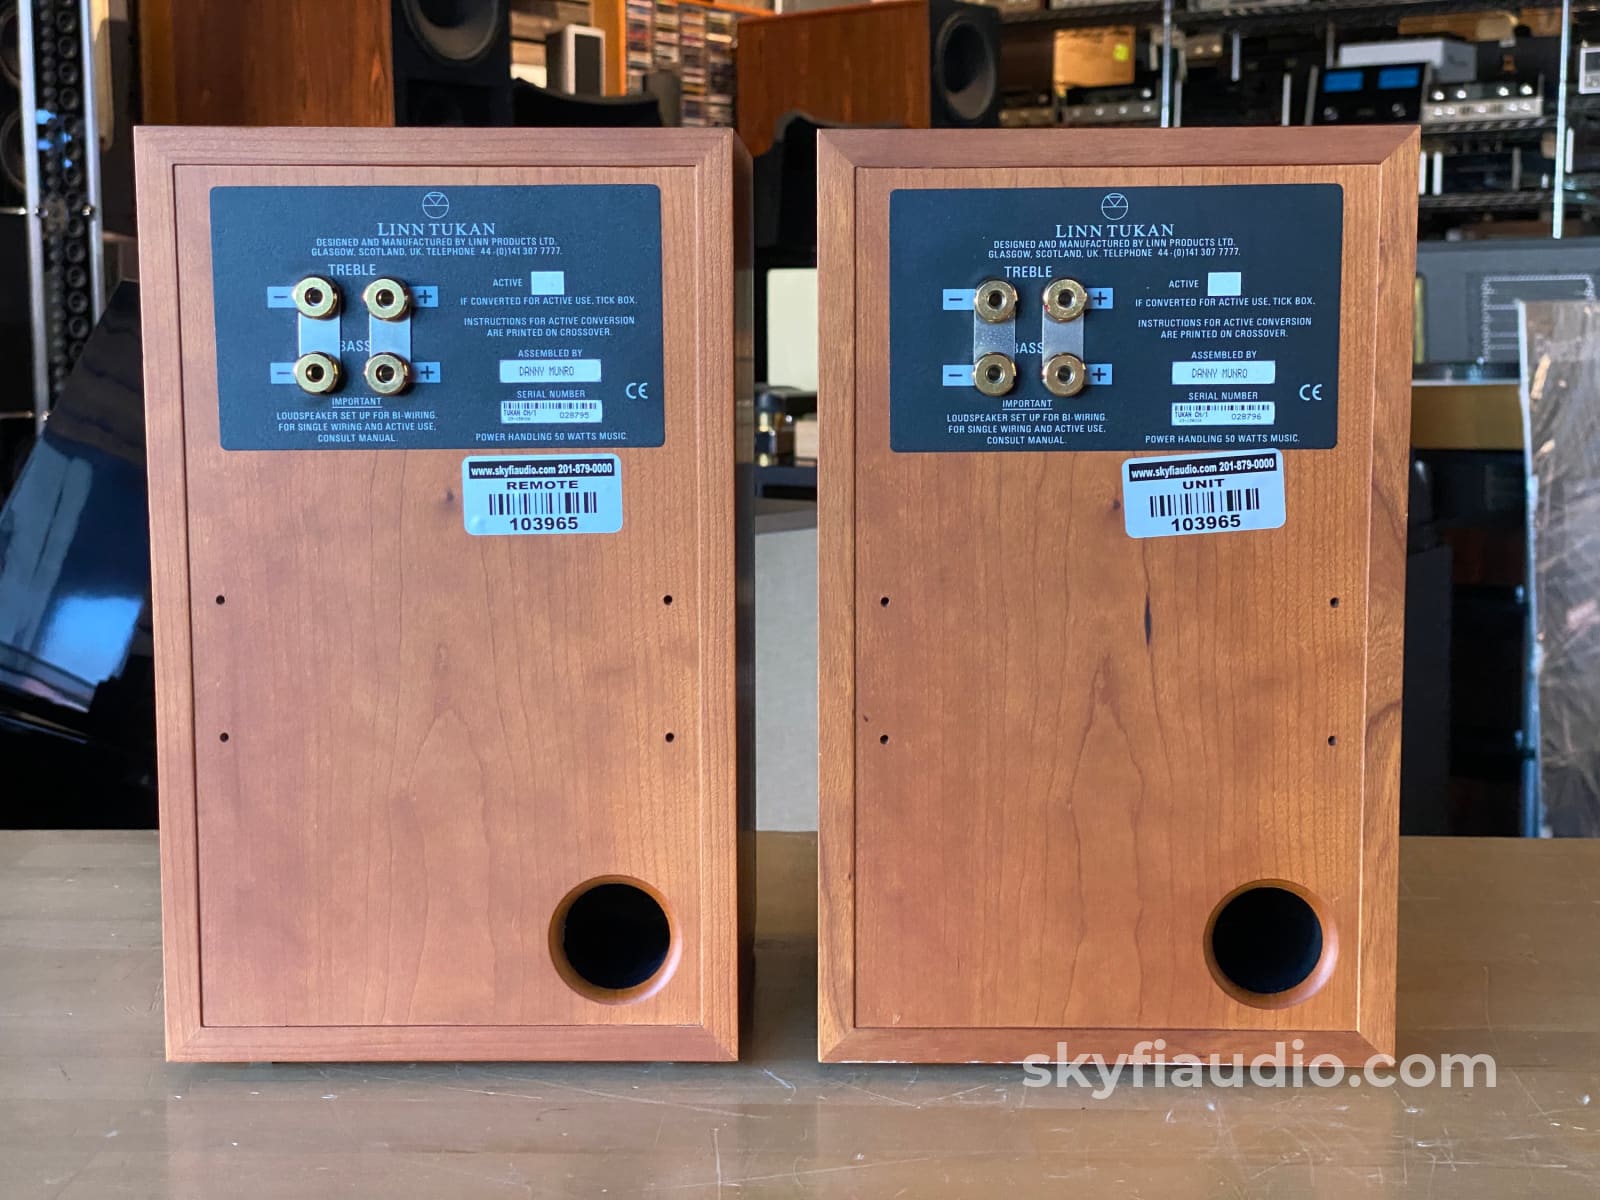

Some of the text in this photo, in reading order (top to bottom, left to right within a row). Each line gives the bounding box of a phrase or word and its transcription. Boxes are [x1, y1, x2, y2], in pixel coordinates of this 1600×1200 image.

[377, 222, 496, 236] LINN TUKAN
[1055, 224, 1175, 238] LINN TUKAN
[316, 238, 359, 246] DESIGNED
[361, 238, 379, 246] AND
[382, 238, 452, 246] MANUFACTURED
[455, 238, 466, 246] BY
[468, 238, 489, 246] LINN
[491, 237, 537, 246] PRODUCTS
[993, 240, 1036, 249] DESIGNED
[1038, 240, 1057, 248] AND
[1059, 239, 1130, 248] MANUFACTURED
[1132, 239, 1144, 247] BY
[1146, 239, 1166, 247] LINN
[1170, 238, 1215, 247] PRODUCTS
[427, 247, 475, 256] TELEPHONE
[522, 247, 537, 256] 307
[539, 246, 562, 255] 7777.
[1104, 248, 1152, 257] TELEPHONE
[1201, 248, 1216, 256] 307
[1218, 248, 1241, 256] 7777.
[328, 264, 377, 276] TREBLE
[1004, 266, 1053, 278] TREBLE
[492, 278, 523, 287] ACTIVE
[1168, 280, 1199, 288] ACTIVE
[460, 297, 467, 305] IF
[471, 297, 521, 305] CONVERTED
[524, 297, 540, 305] FOR
[543, 296, 573, 304] ACTIVE
[596, 296, 615, 304] TICK
[618, 296, 638, 304] BOX.
[1135, 299, 1143, 307] IF
[1146, 299, 1196, 307] CONVERTED
[1200, 298, 1216, 306] FOR
[1218, 298, 1249, 306] ACTIVE
[1273, 297, 1292, 305] TICK
[1295, 297, 1316, 305] BOX.
[464, 317, 635, 326] INSTRUCTIONS FOR ACTIVE CONVERSION
[1138, 318, 1312, 328] INSTRUCTIONS FOR ACTIVE CONVERSION
[506, 328, 543, 336] PRINTED
[545, 328, 558, 336] ON
[1161, 330, 1178, 339] ARE
[1181, 330, 1218, 338] PRINTED
[1220, 330, 1232, 338] ON
[1191, 351, 1244, 359] ASSEMBLED
[519, 366, 574, 376] DANNY MUNRO
[1192, 368, 1248, 378] DANNY MUNRO
[517, 390, 586, 398] SERIAL NUMBER
[626, 382, 648, 399] CE
[1299, 384, 1322, 401] CE
[1188, 392, 1258, 400] SERIAL NUMBER
[332, 397, 382, 406] IMPORTANT
[1002, 400, 1052, 408] IMPORTANT
[277, 411, 338, 420] LOUDSPEAKER
[341, 411, 356, 419] SET
[360, 411, 370, 419] UP
[373, 411, 389, 419] FOR
[947, 414, 1008, 422] LOUDSPEAKER
[1011, 414, 1026, 422] SET
[1030, 414, 1040, 422] UP
[1231, 413, 1262, 421] 028796
[278, 423, 295, 431] FOR
[298, 423, 328, 431] SINGLE
[331, 422, 362, 431] WIRING
[365, 422, 383, 431] AND
[386, 422, 414, 430] ACTIVE
[948, 426, 965, 434] FOR
[968, 425, 997, 433] SINGLE
[1001, 425, 1032, 433] WIRING
[1034, 425, 1051, 433] AND
[318, 434, 356, 442] CONSULT
[476, 433, 506, 441] POWER
[508, 432, 552, 440] HANDLING
[554, 432, 564, 440] 50
[567, 432, 597, 440] WATTS
[987, 437, 1025, 445] CONSULT
[1178, 435, 1222, 443] HANDLING
[1270, 434, 1300, 442] MUSIC.
[470, 463, 612, 478] www.skyfiaudio.com 201-879-0000
[1131, 458, 1274, 479] www.skyfiaudio.com 201-879-0000
[507, 480, 579, 490] REMOTE
[1182, 479, 1224, 489] UNIT
[510, 517, 579, 531] 103965
[1171, 514, 1241, 531] 103965
